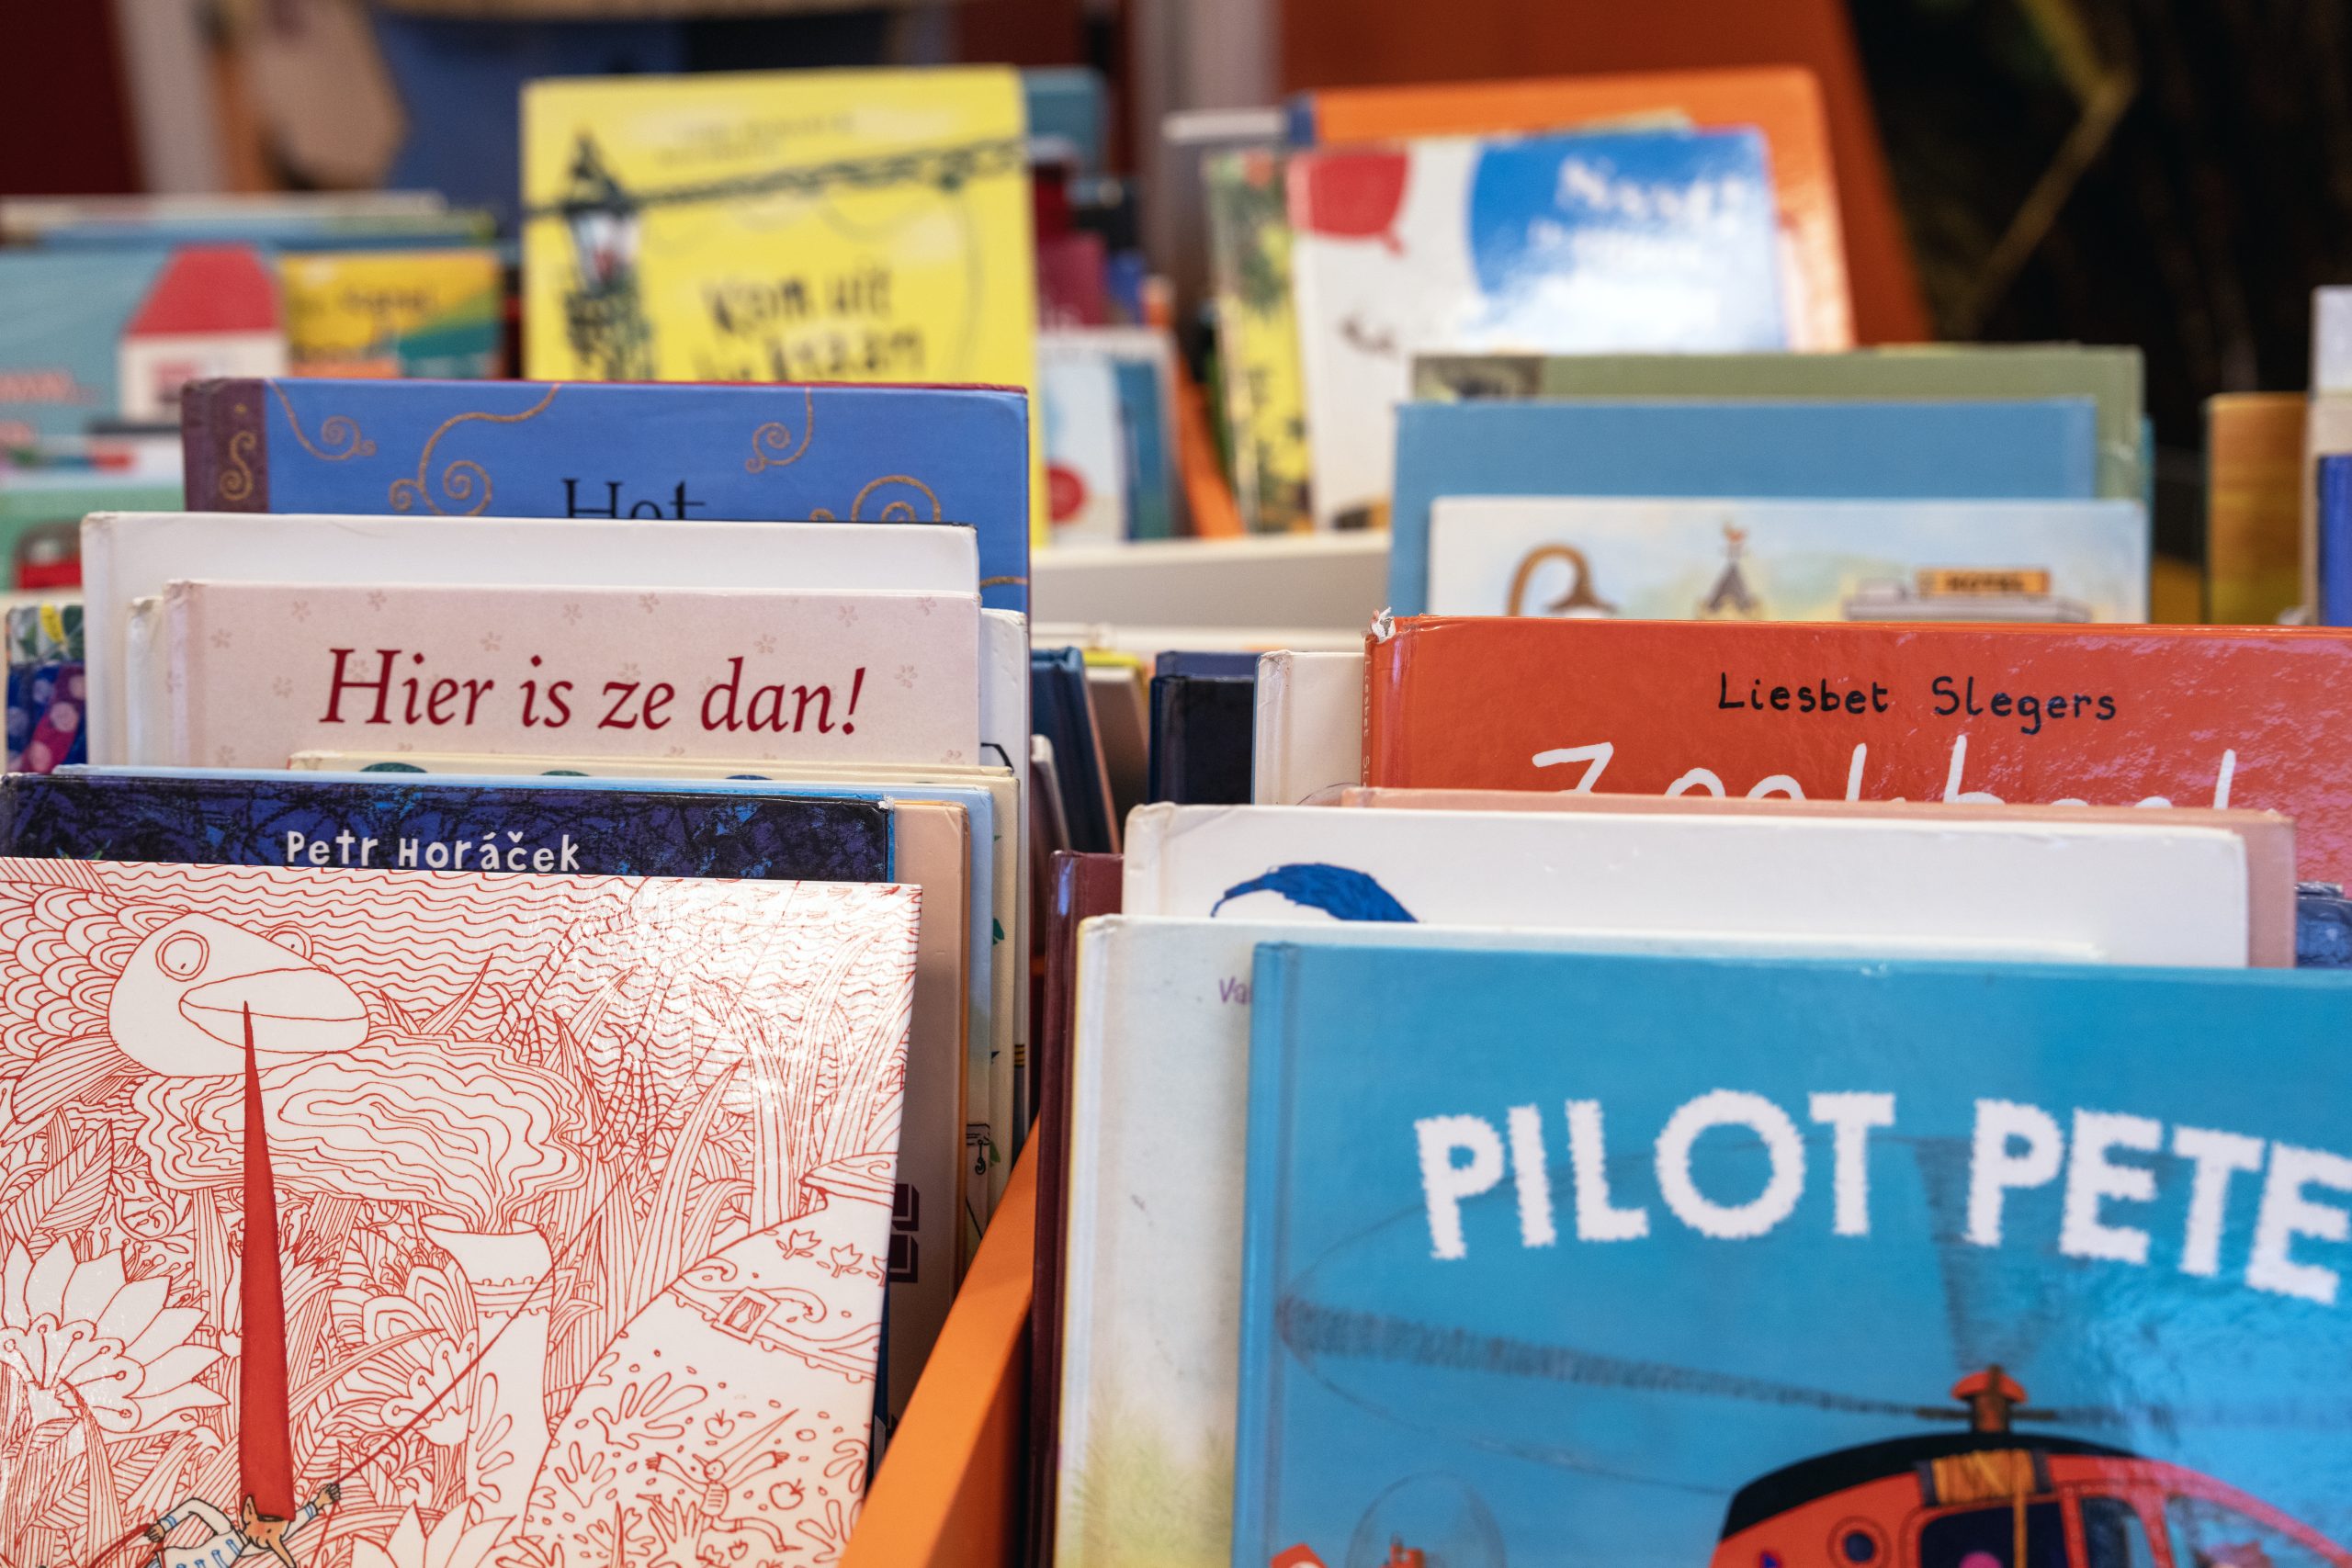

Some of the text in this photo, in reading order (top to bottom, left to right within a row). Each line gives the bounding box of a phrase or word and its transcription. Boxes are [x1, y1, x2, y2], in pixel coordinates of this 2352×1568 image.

[319, 648, 866, 736] Hier is ze dan!
[1717, 671, 2117, 736] Liesbet Slegers
[287, 829, 581, 872] Petr Horáček
[1414, 1089, 2352, 1305] PILOT PETE
